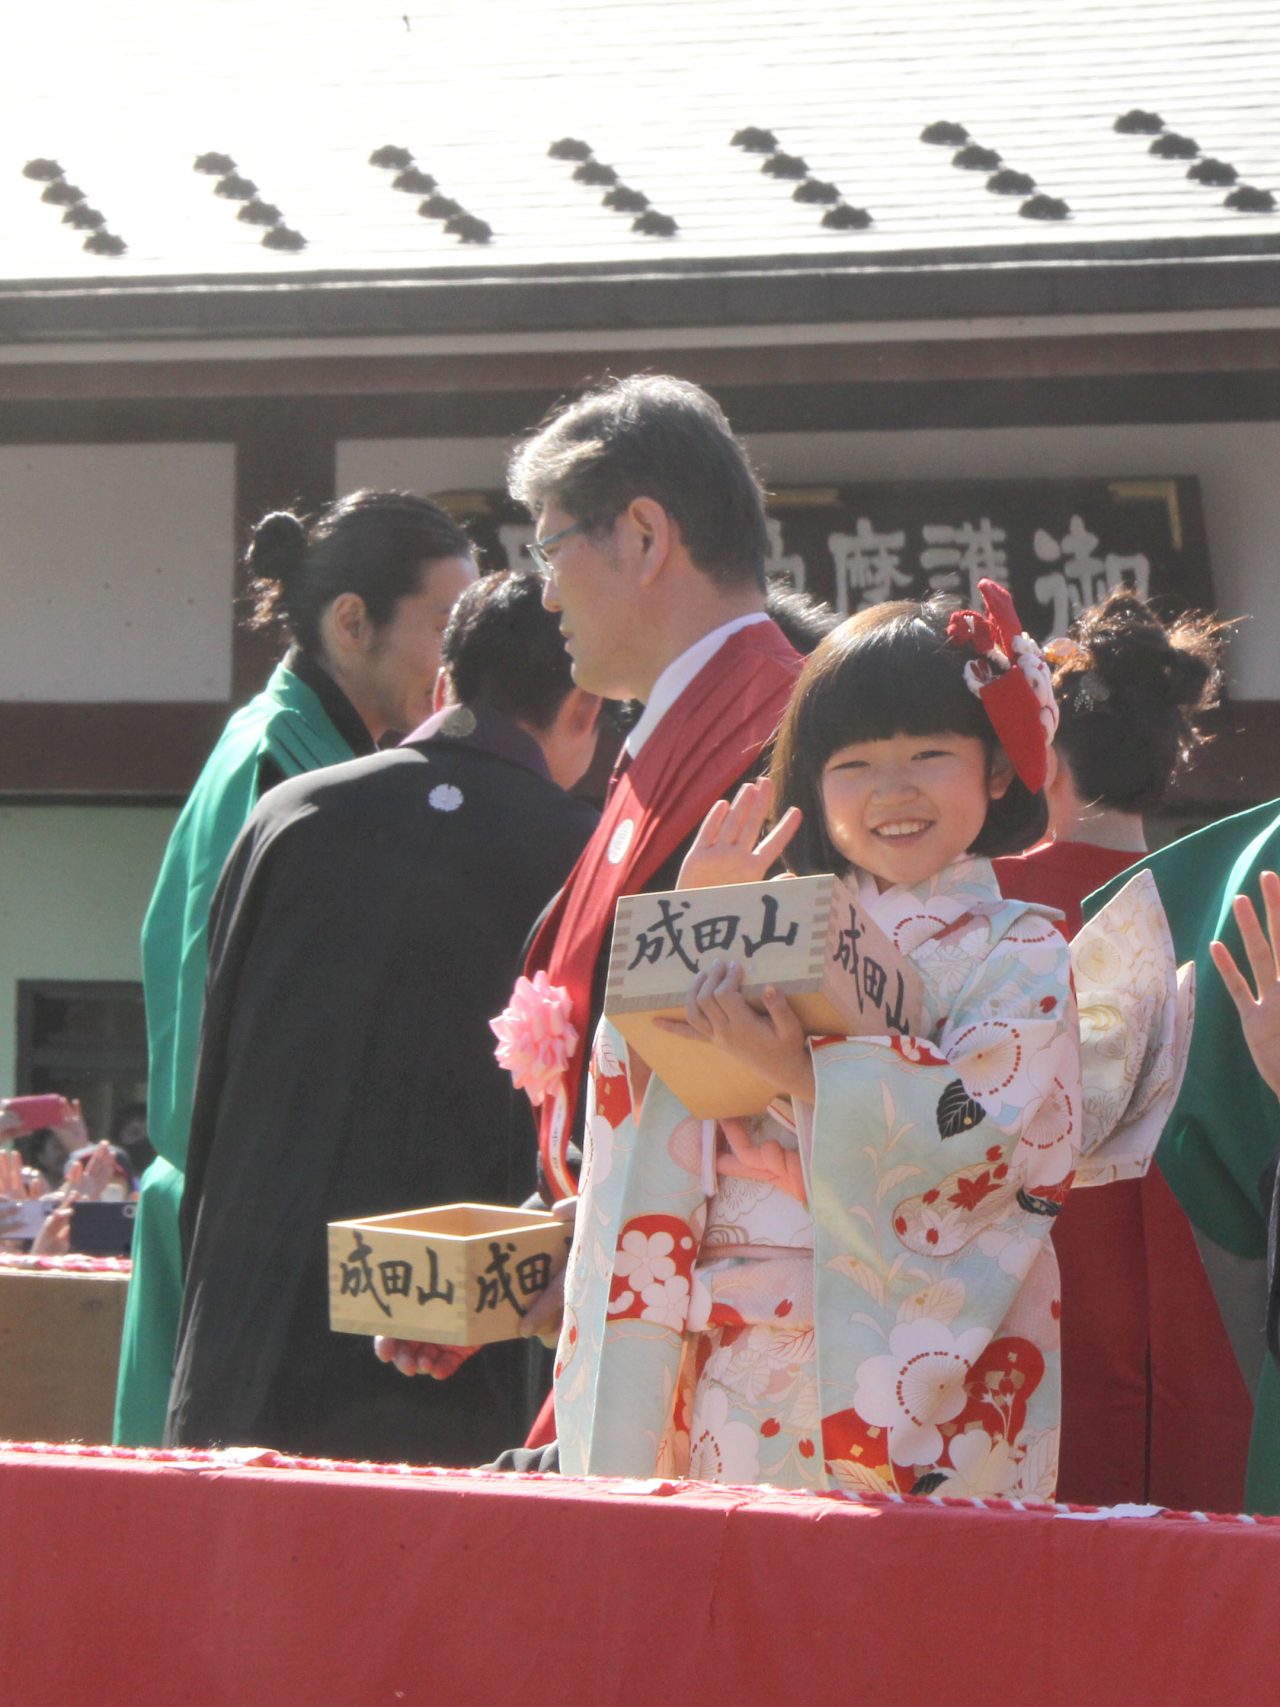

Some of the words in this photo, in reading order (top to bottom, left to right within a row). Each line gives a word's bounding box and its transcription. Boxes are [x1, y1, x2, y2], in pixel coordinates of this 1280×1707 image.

[628, 894, 798, 974] 成田山
[833, 904, 909, 1034] 成田山
[340, 1231, 454, 1318] 成田山
[475, 1242, 573, 1318] 成田
